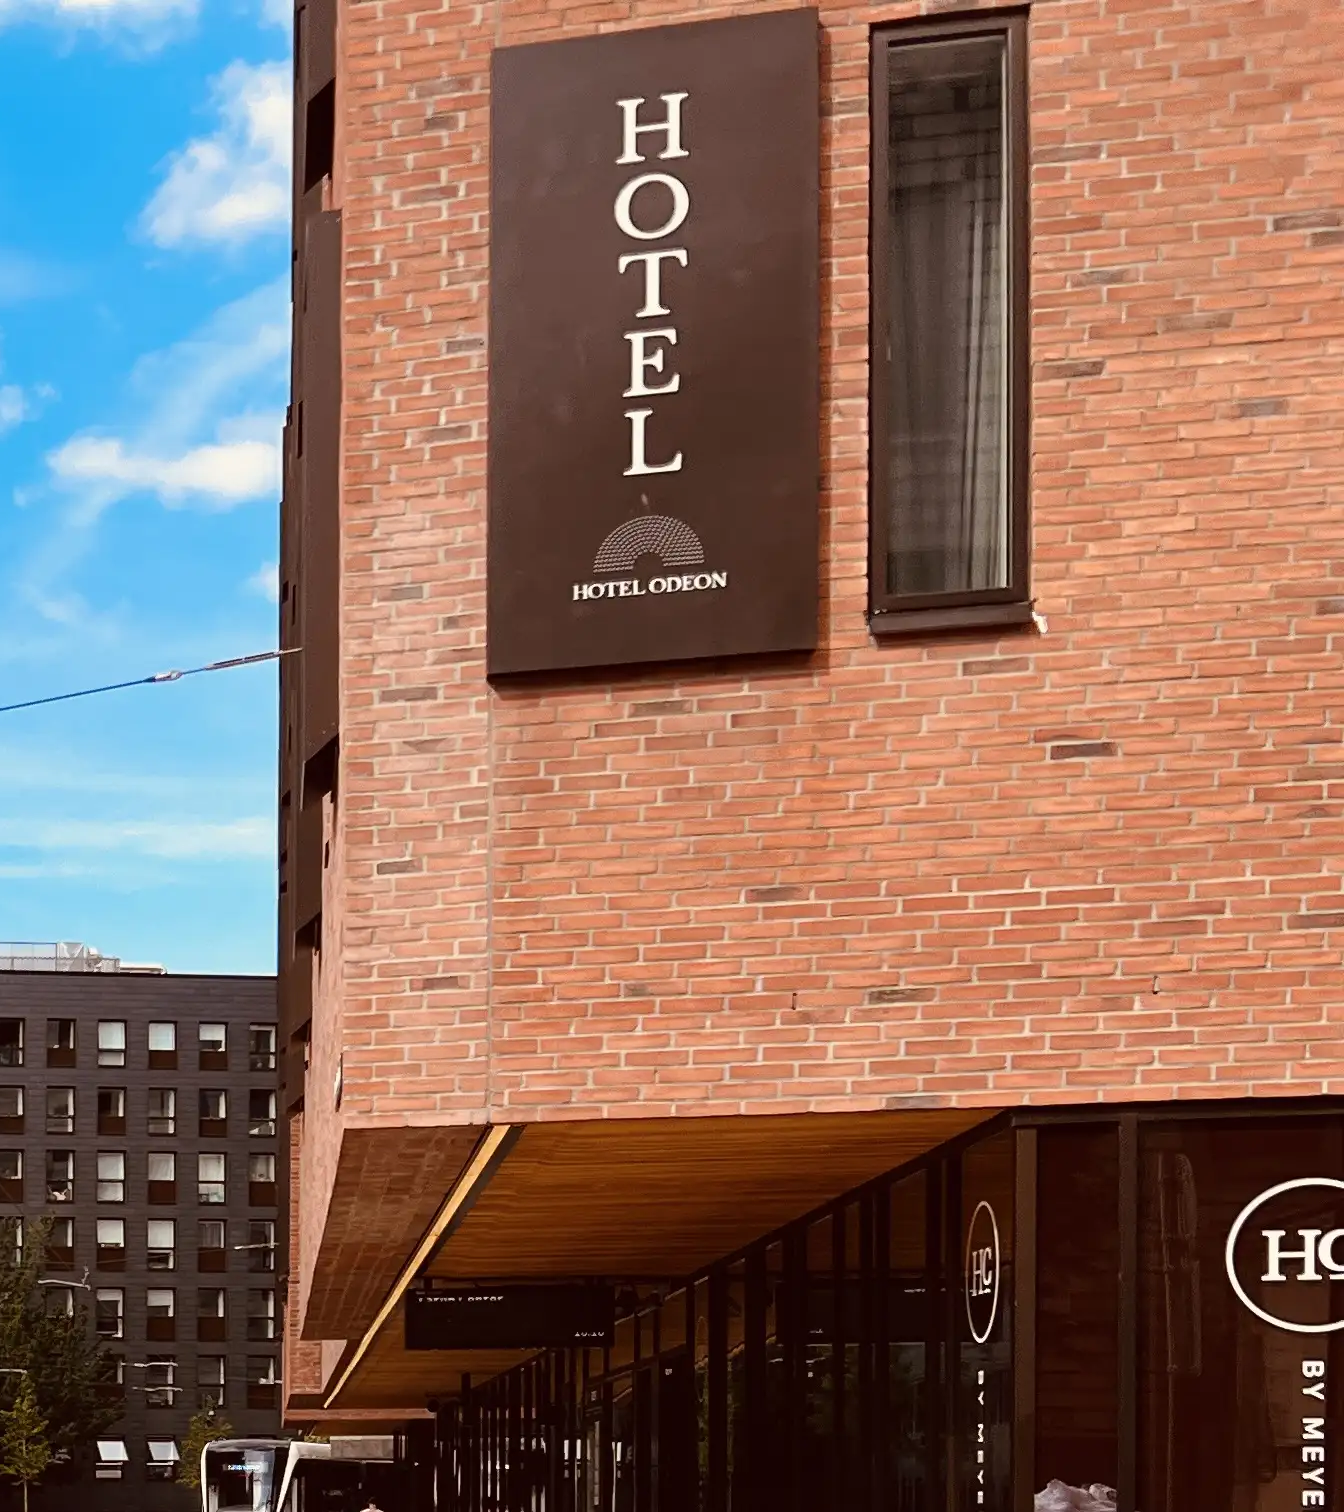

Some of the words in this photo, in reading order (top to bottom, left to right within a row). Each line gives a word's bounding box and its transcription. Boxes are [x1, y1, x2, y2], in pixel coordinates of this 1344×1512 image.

[613, 91, 691, 477] HOTEL
[572, 577, 646, 601] HOTEL
[649, 571, 728, 596] ODEON
[1302, 1359, 1325, 1400] BY
